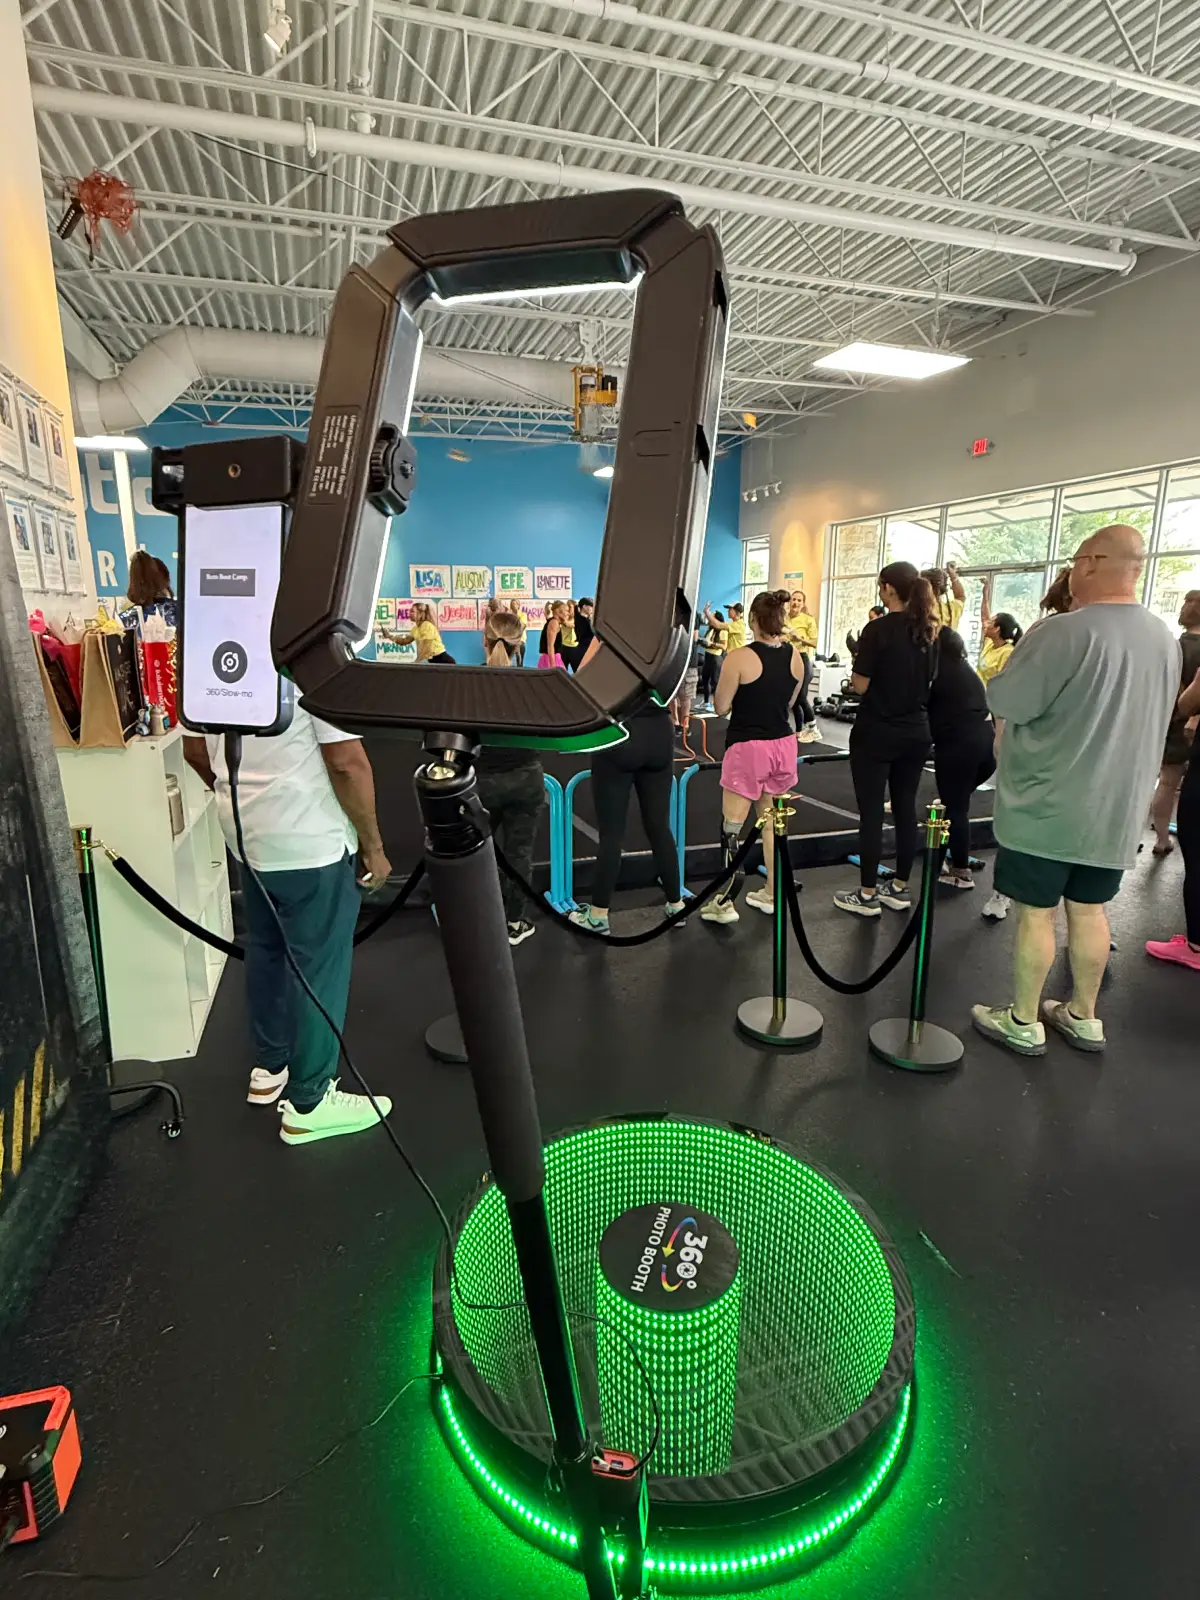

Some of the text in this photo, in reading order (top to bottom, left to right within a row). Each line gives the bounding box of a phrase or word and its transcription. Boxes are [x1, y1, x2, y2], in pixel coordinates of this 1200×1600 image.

[501, 572, 525, 589] EFE
[537, 575, 570, 590] LYNETTE
[630, 1206, 672, 1292] PHOTO BOOTH
